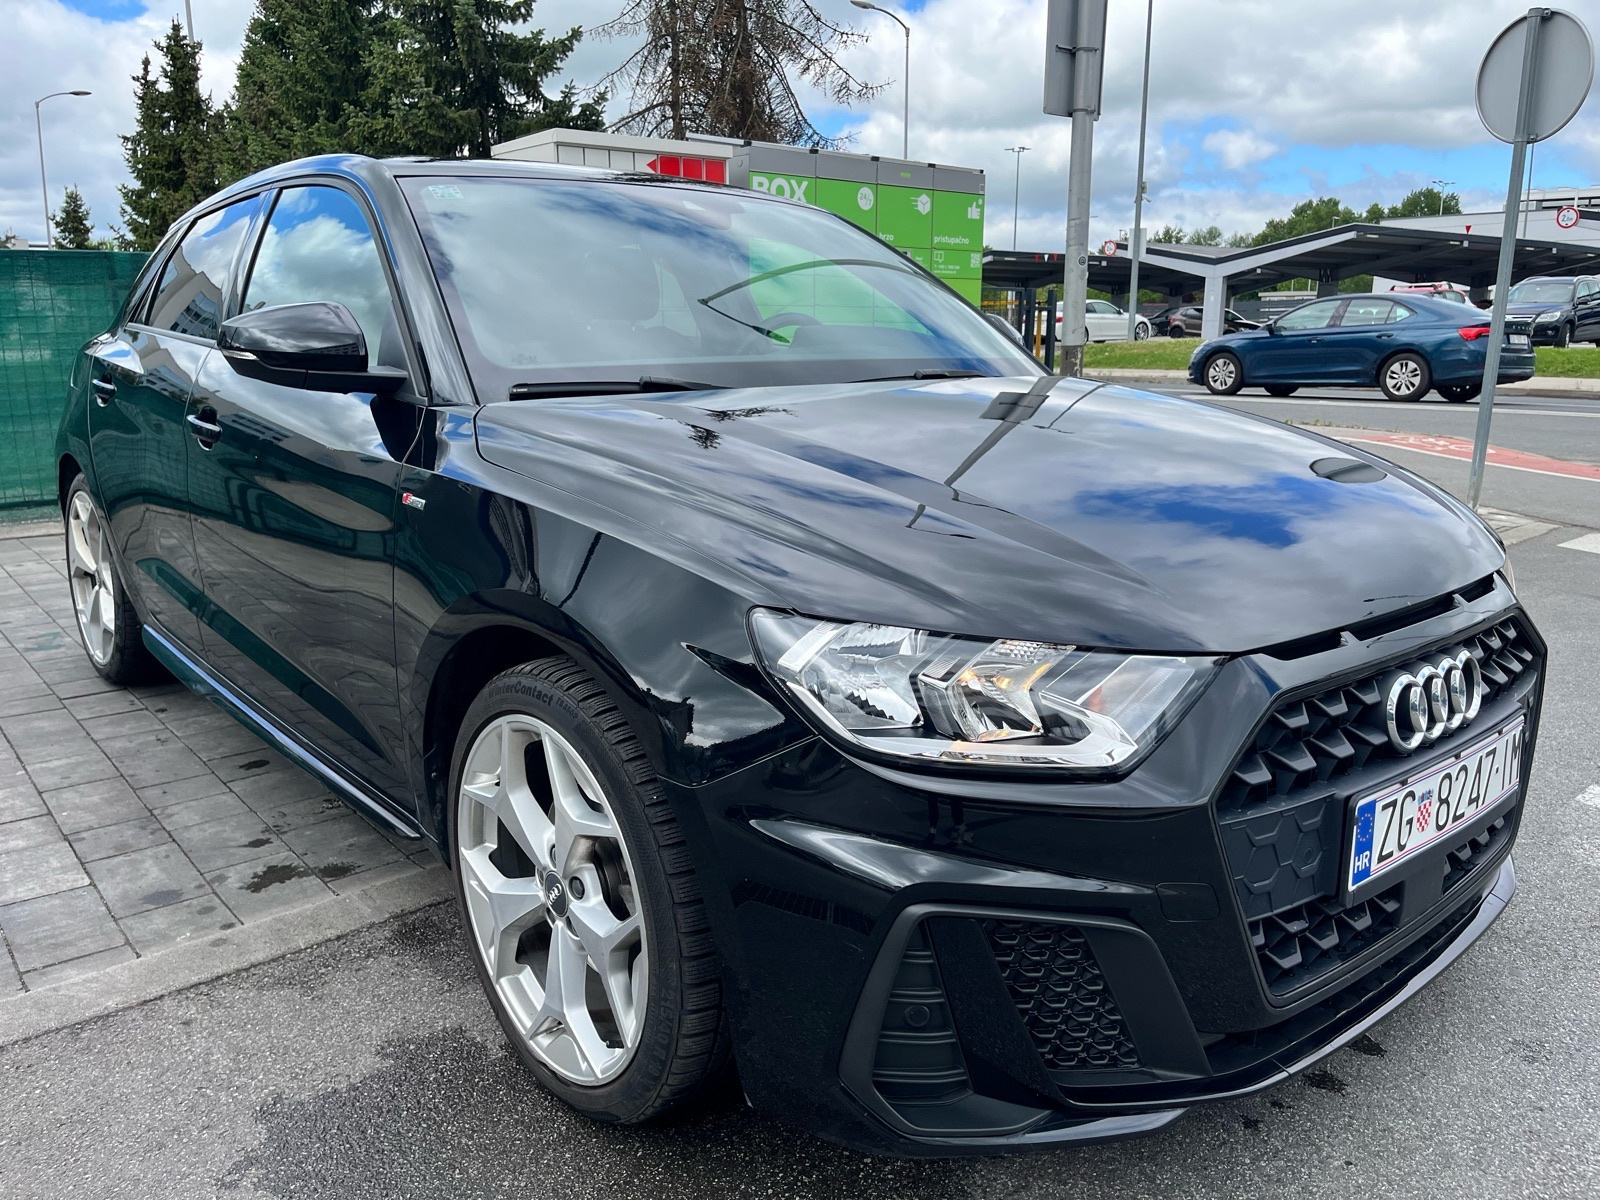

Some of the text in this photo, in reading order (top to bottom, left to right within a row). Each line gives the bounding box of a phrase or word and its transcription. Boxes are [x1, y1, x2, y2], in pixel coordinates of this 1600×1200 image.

[753, 176, 808, 203] BOX
[934, 234, 970, 245] pristupačno
[488, 680, 554, 706] WinterContact
[1376, 790, 1416, 865] ZG
[1354, 851, 1370, 874] HR
